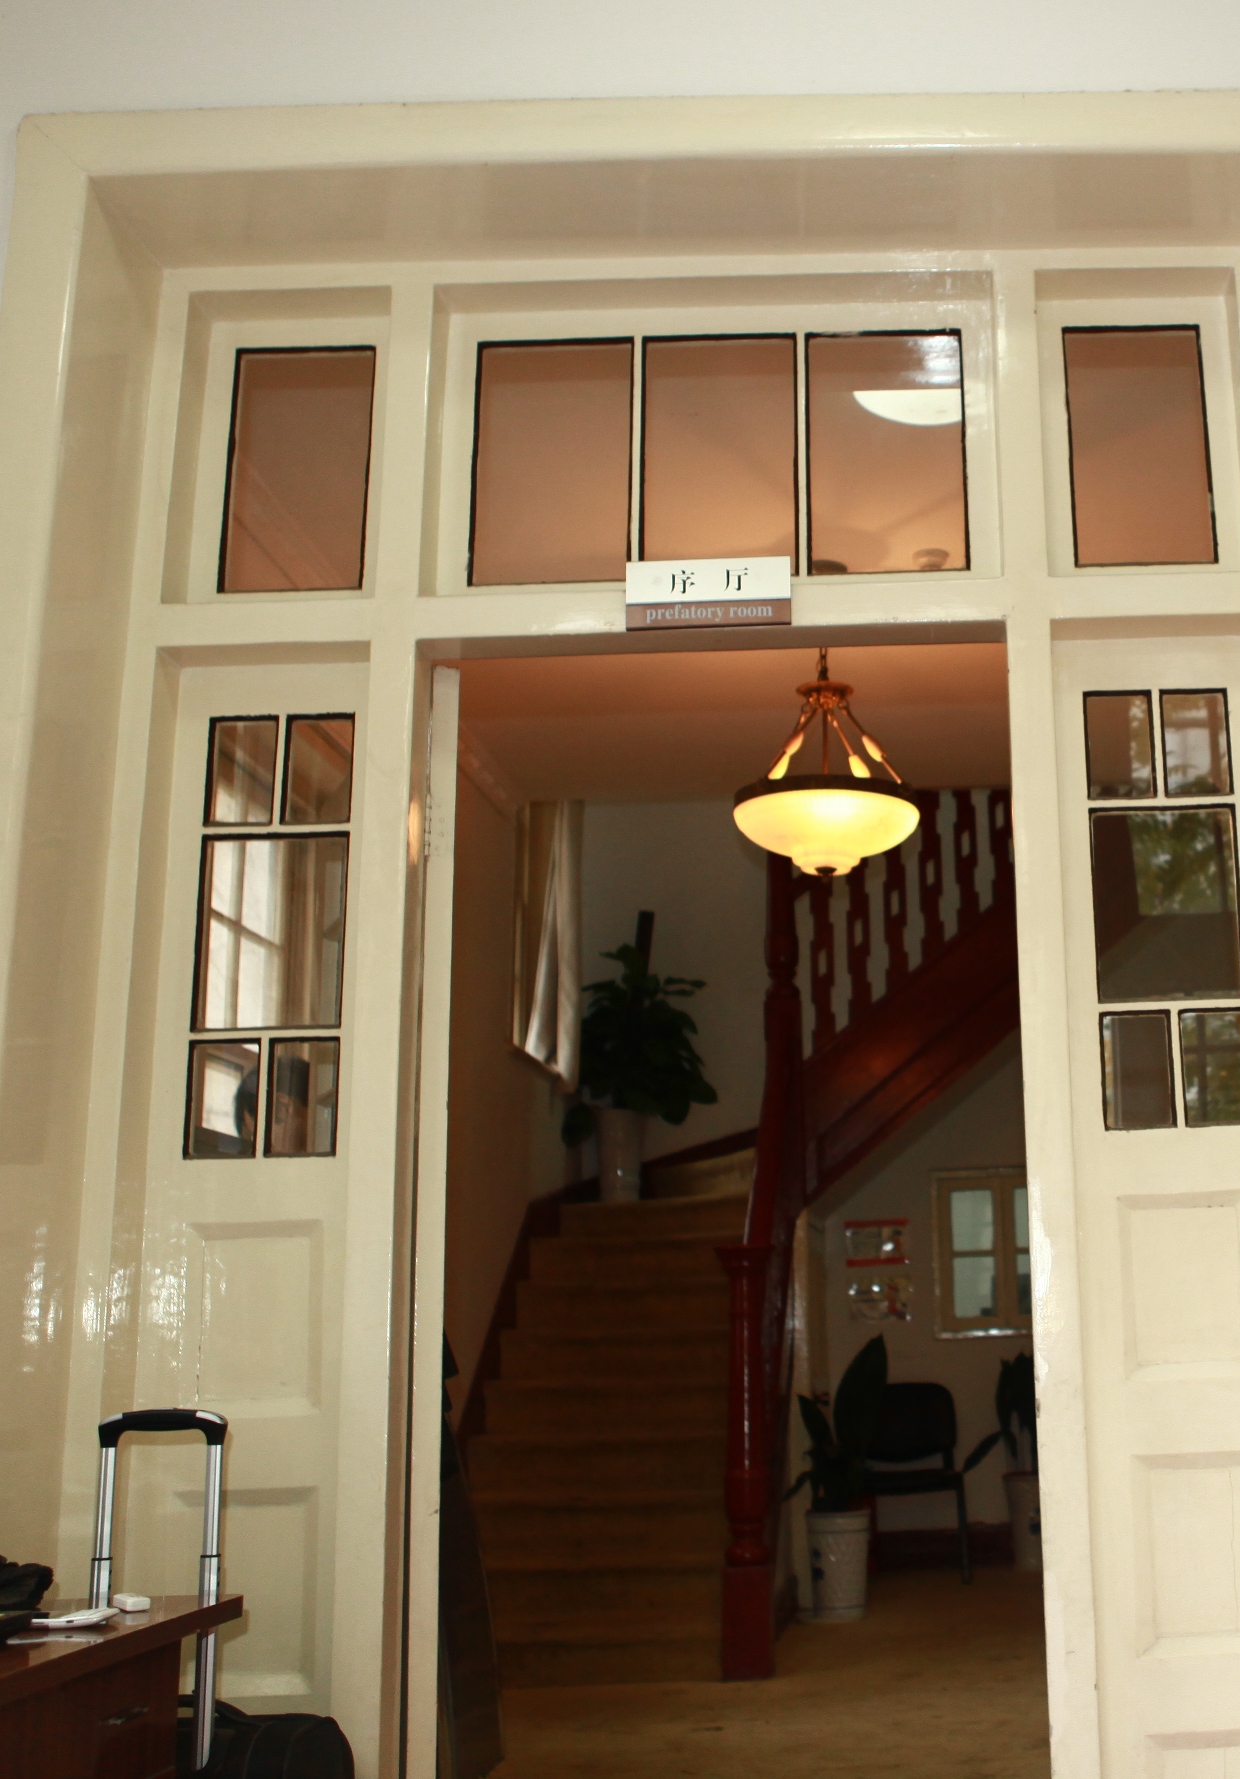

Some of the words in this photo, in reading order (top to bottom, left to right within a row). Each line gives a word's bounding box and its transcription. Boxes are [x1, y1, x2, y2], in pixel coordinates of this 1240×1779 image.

[671, 567, 749, 594] 序厅
[646, 604, 725, 623] prefatory
[729, 604, 773, 617] room
